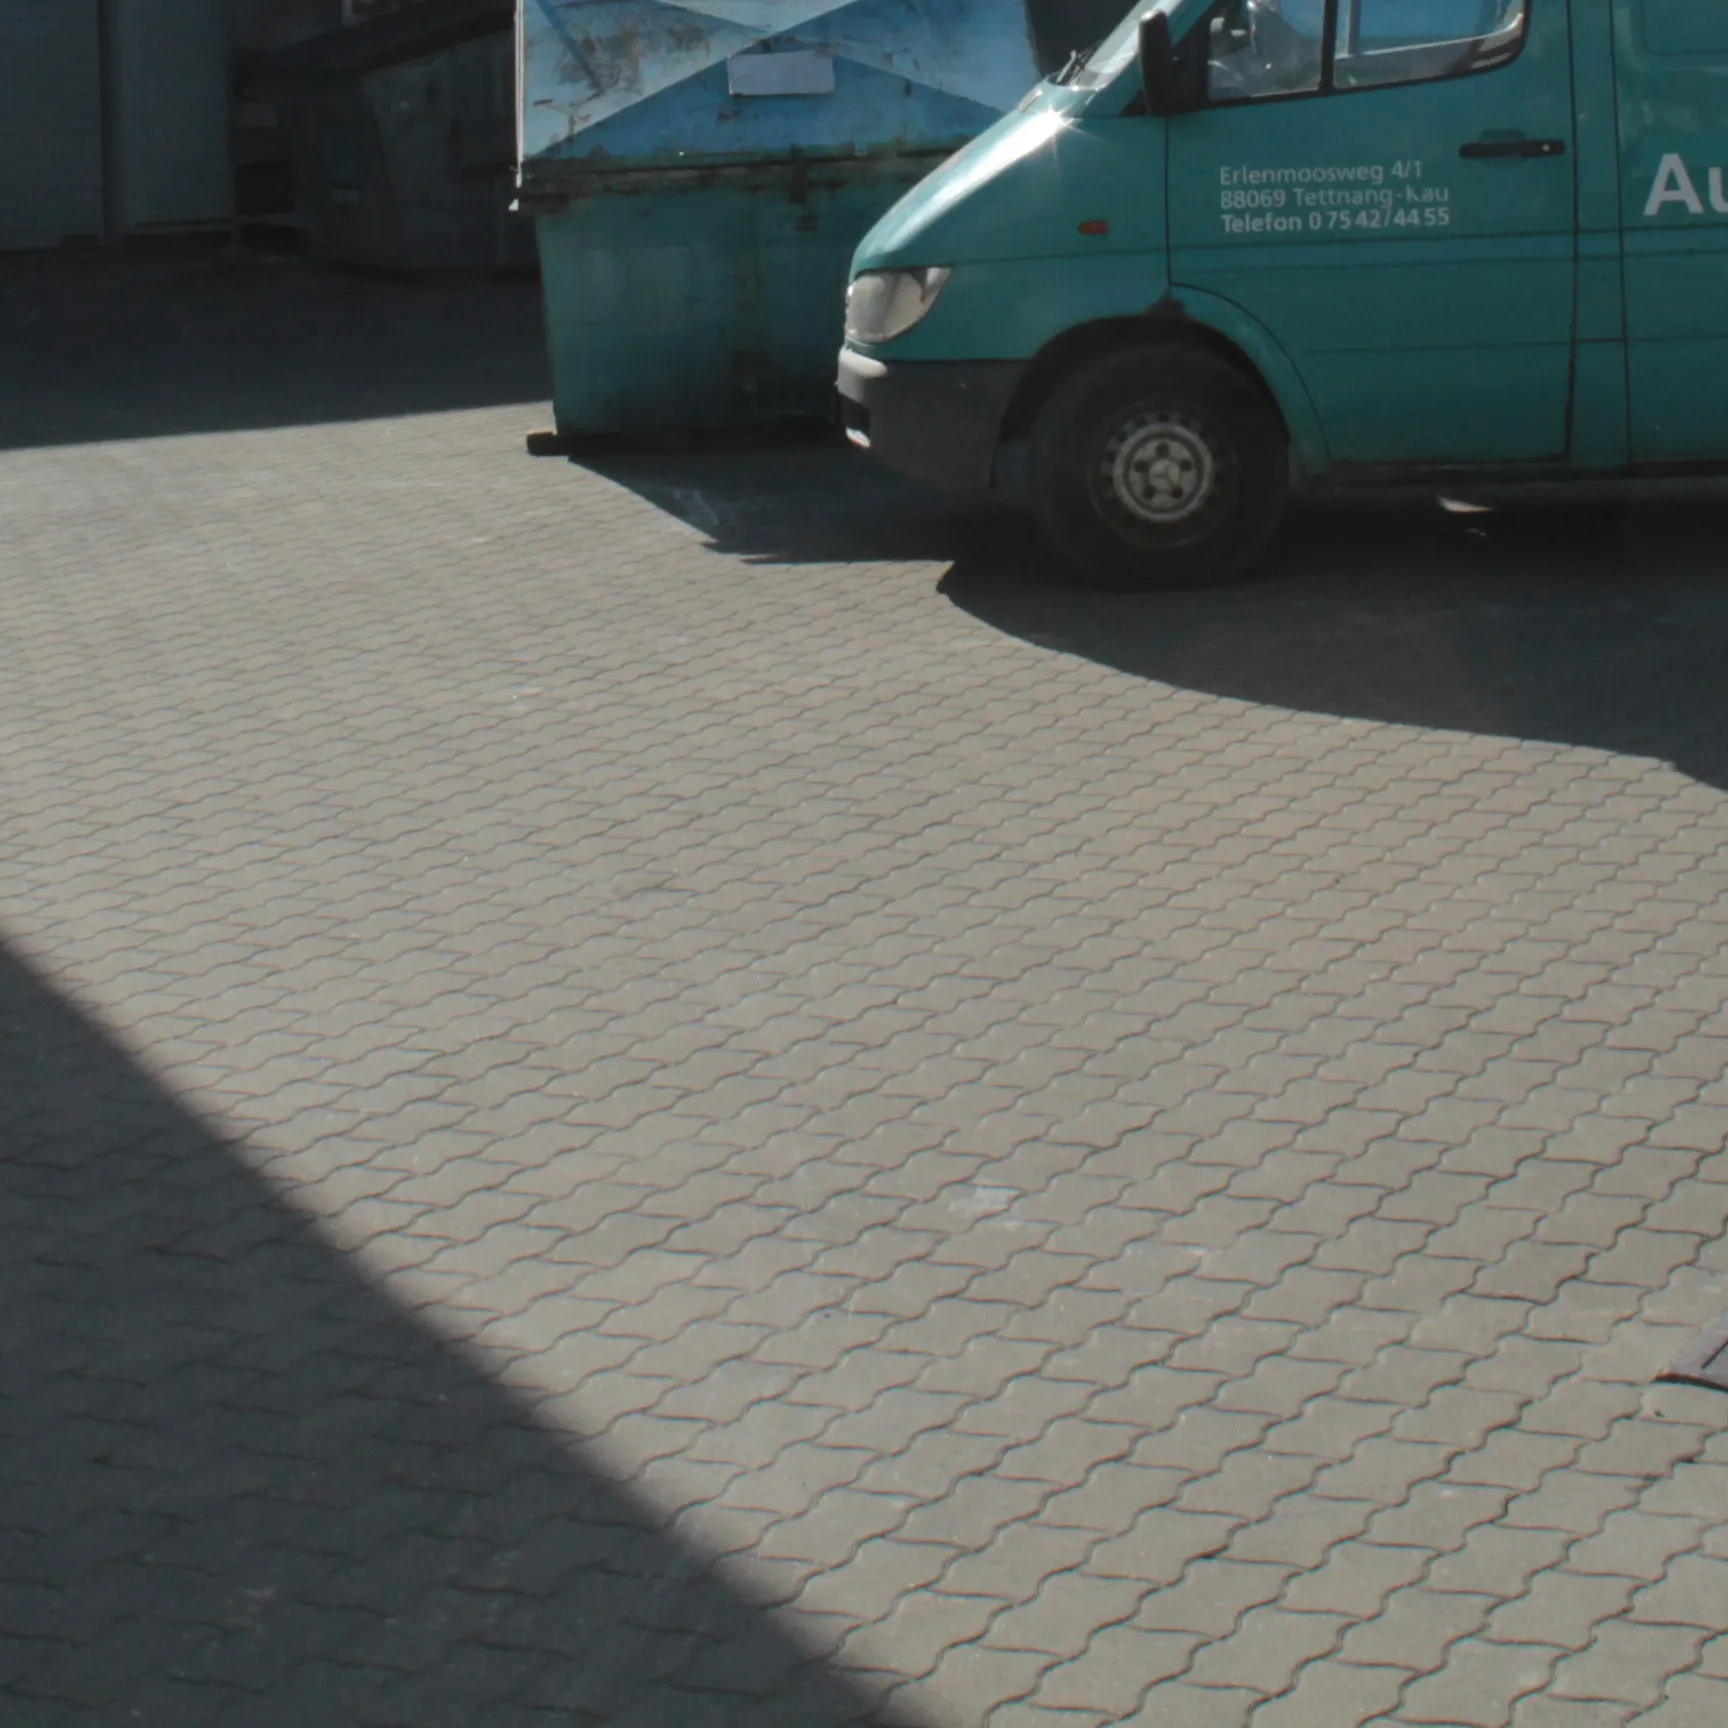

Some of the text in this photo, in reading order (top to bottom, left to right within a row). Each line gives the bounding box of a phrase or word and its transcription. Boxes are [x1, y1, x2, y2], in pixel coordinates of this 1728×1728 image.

[1219, 160, 1423, 186] Erlenmoosweg 4/1
[1219, 189, 1286, 209] 88069
[1220, 212, 1302, 233] Telefon
